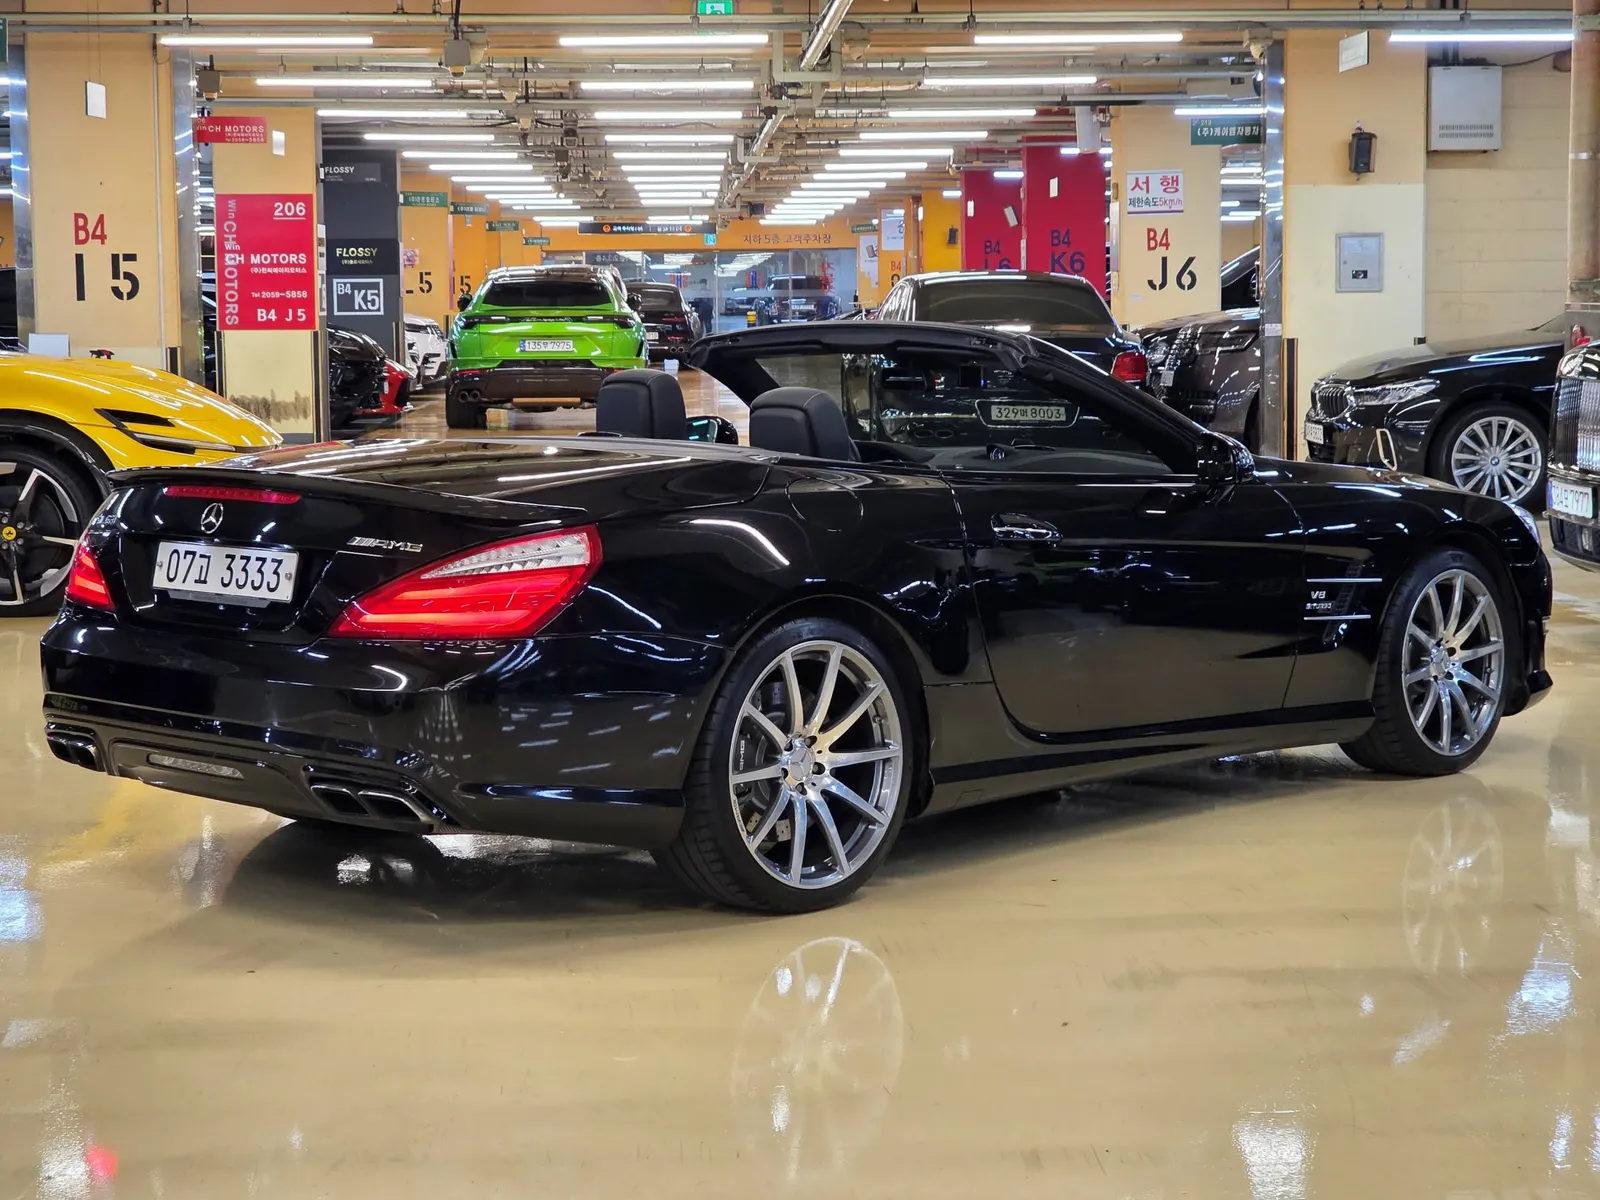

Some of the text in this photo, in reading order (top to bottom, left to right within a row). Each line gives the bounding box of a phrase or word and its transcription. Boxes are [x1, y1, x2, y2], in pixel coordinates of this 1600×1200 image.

[224, 125, 265, 133] MOTORS
[324, 166, 355, 174] FLOSSY
[273, 201, 307, 217] 206
[73, 212, 108, 246] B4
[743, 233, 762, 245] 지하
[1050, 229, 1072, 248] B4
[1146, 227, 1171, 251] B4
[335, 247, 378, 257] FLOSSY
[984, 240, 1002, 255] B4
[250, 253, 308, 265] MOTORS
[1050, 251, 1086, 274] K6
[1146, 255, 1198, 291] J6
[261, 289, 308, 299] 2059-5858
[337, 283, 381, 311] B4 K5
[256, 308, 278, 322] B4
[550, 340, 572, 350] 7975
[1030, 407, 1062, 419] 8003
[166, 548, 284, 593] 07고 3333
[1310, 590, 1327, 600] V8
